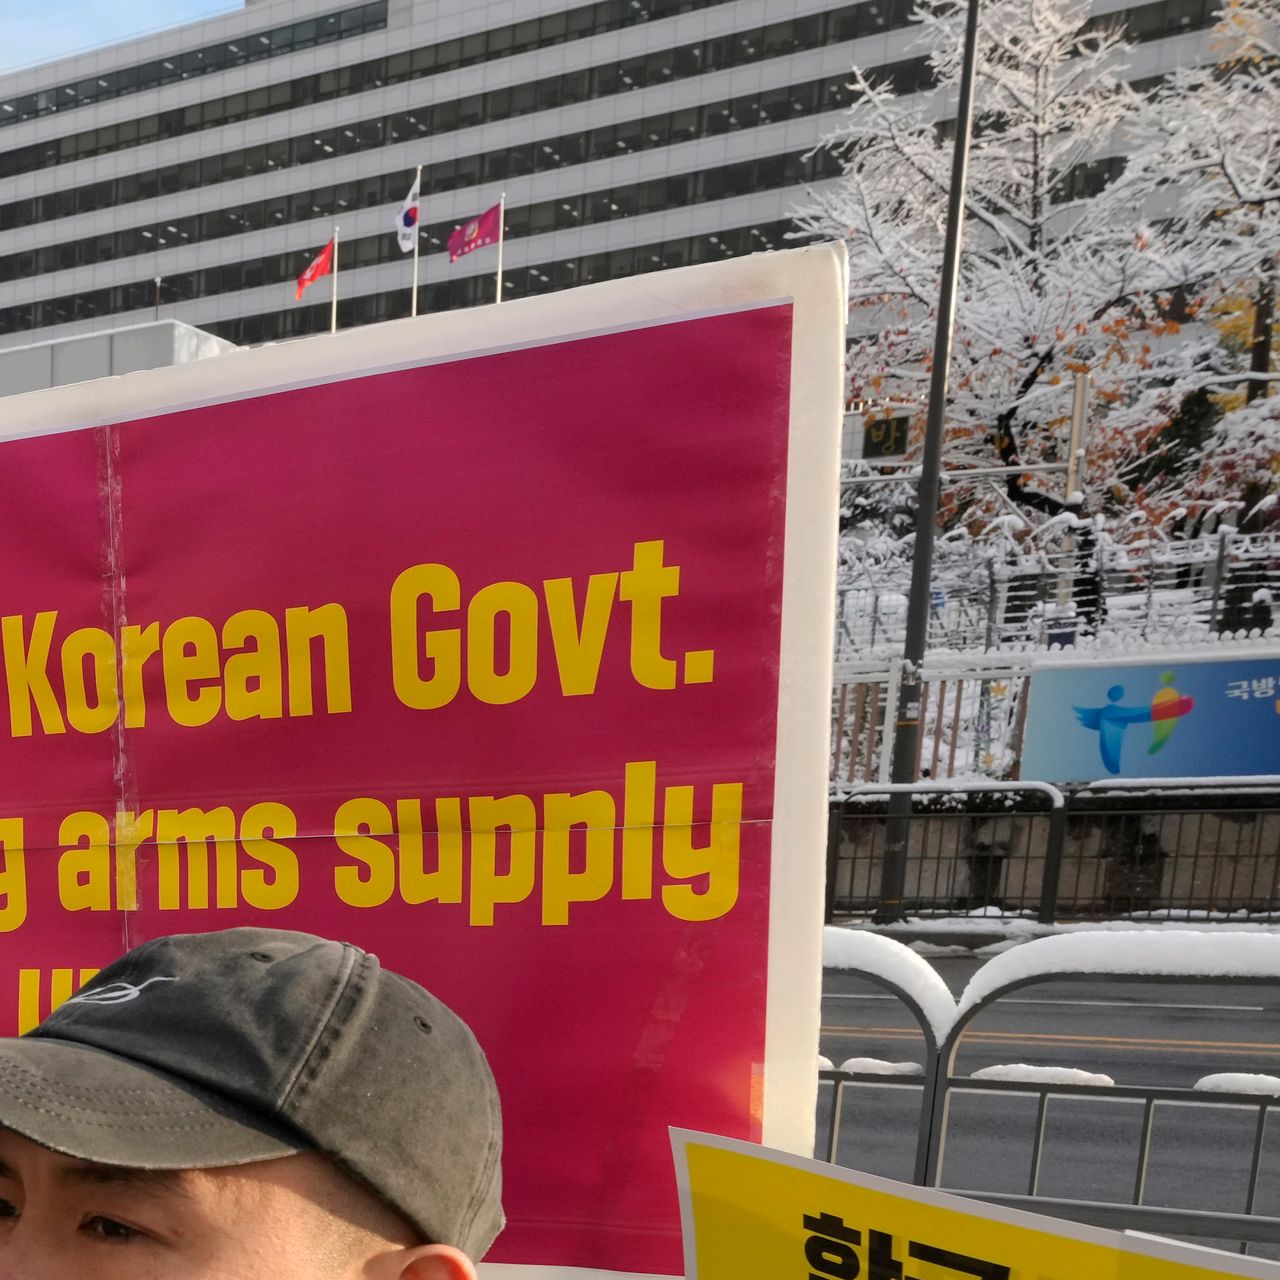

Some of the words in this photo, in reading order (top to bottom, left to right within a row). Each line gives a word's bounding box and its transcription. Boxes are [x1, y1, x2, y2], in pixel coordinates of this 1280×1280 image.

[389, 539, 716, 711] Govt.
[1224, 675, 1280, 701] 국방
[57, 799, 299, 914] arms
[333, 760, 744, 926] supply
